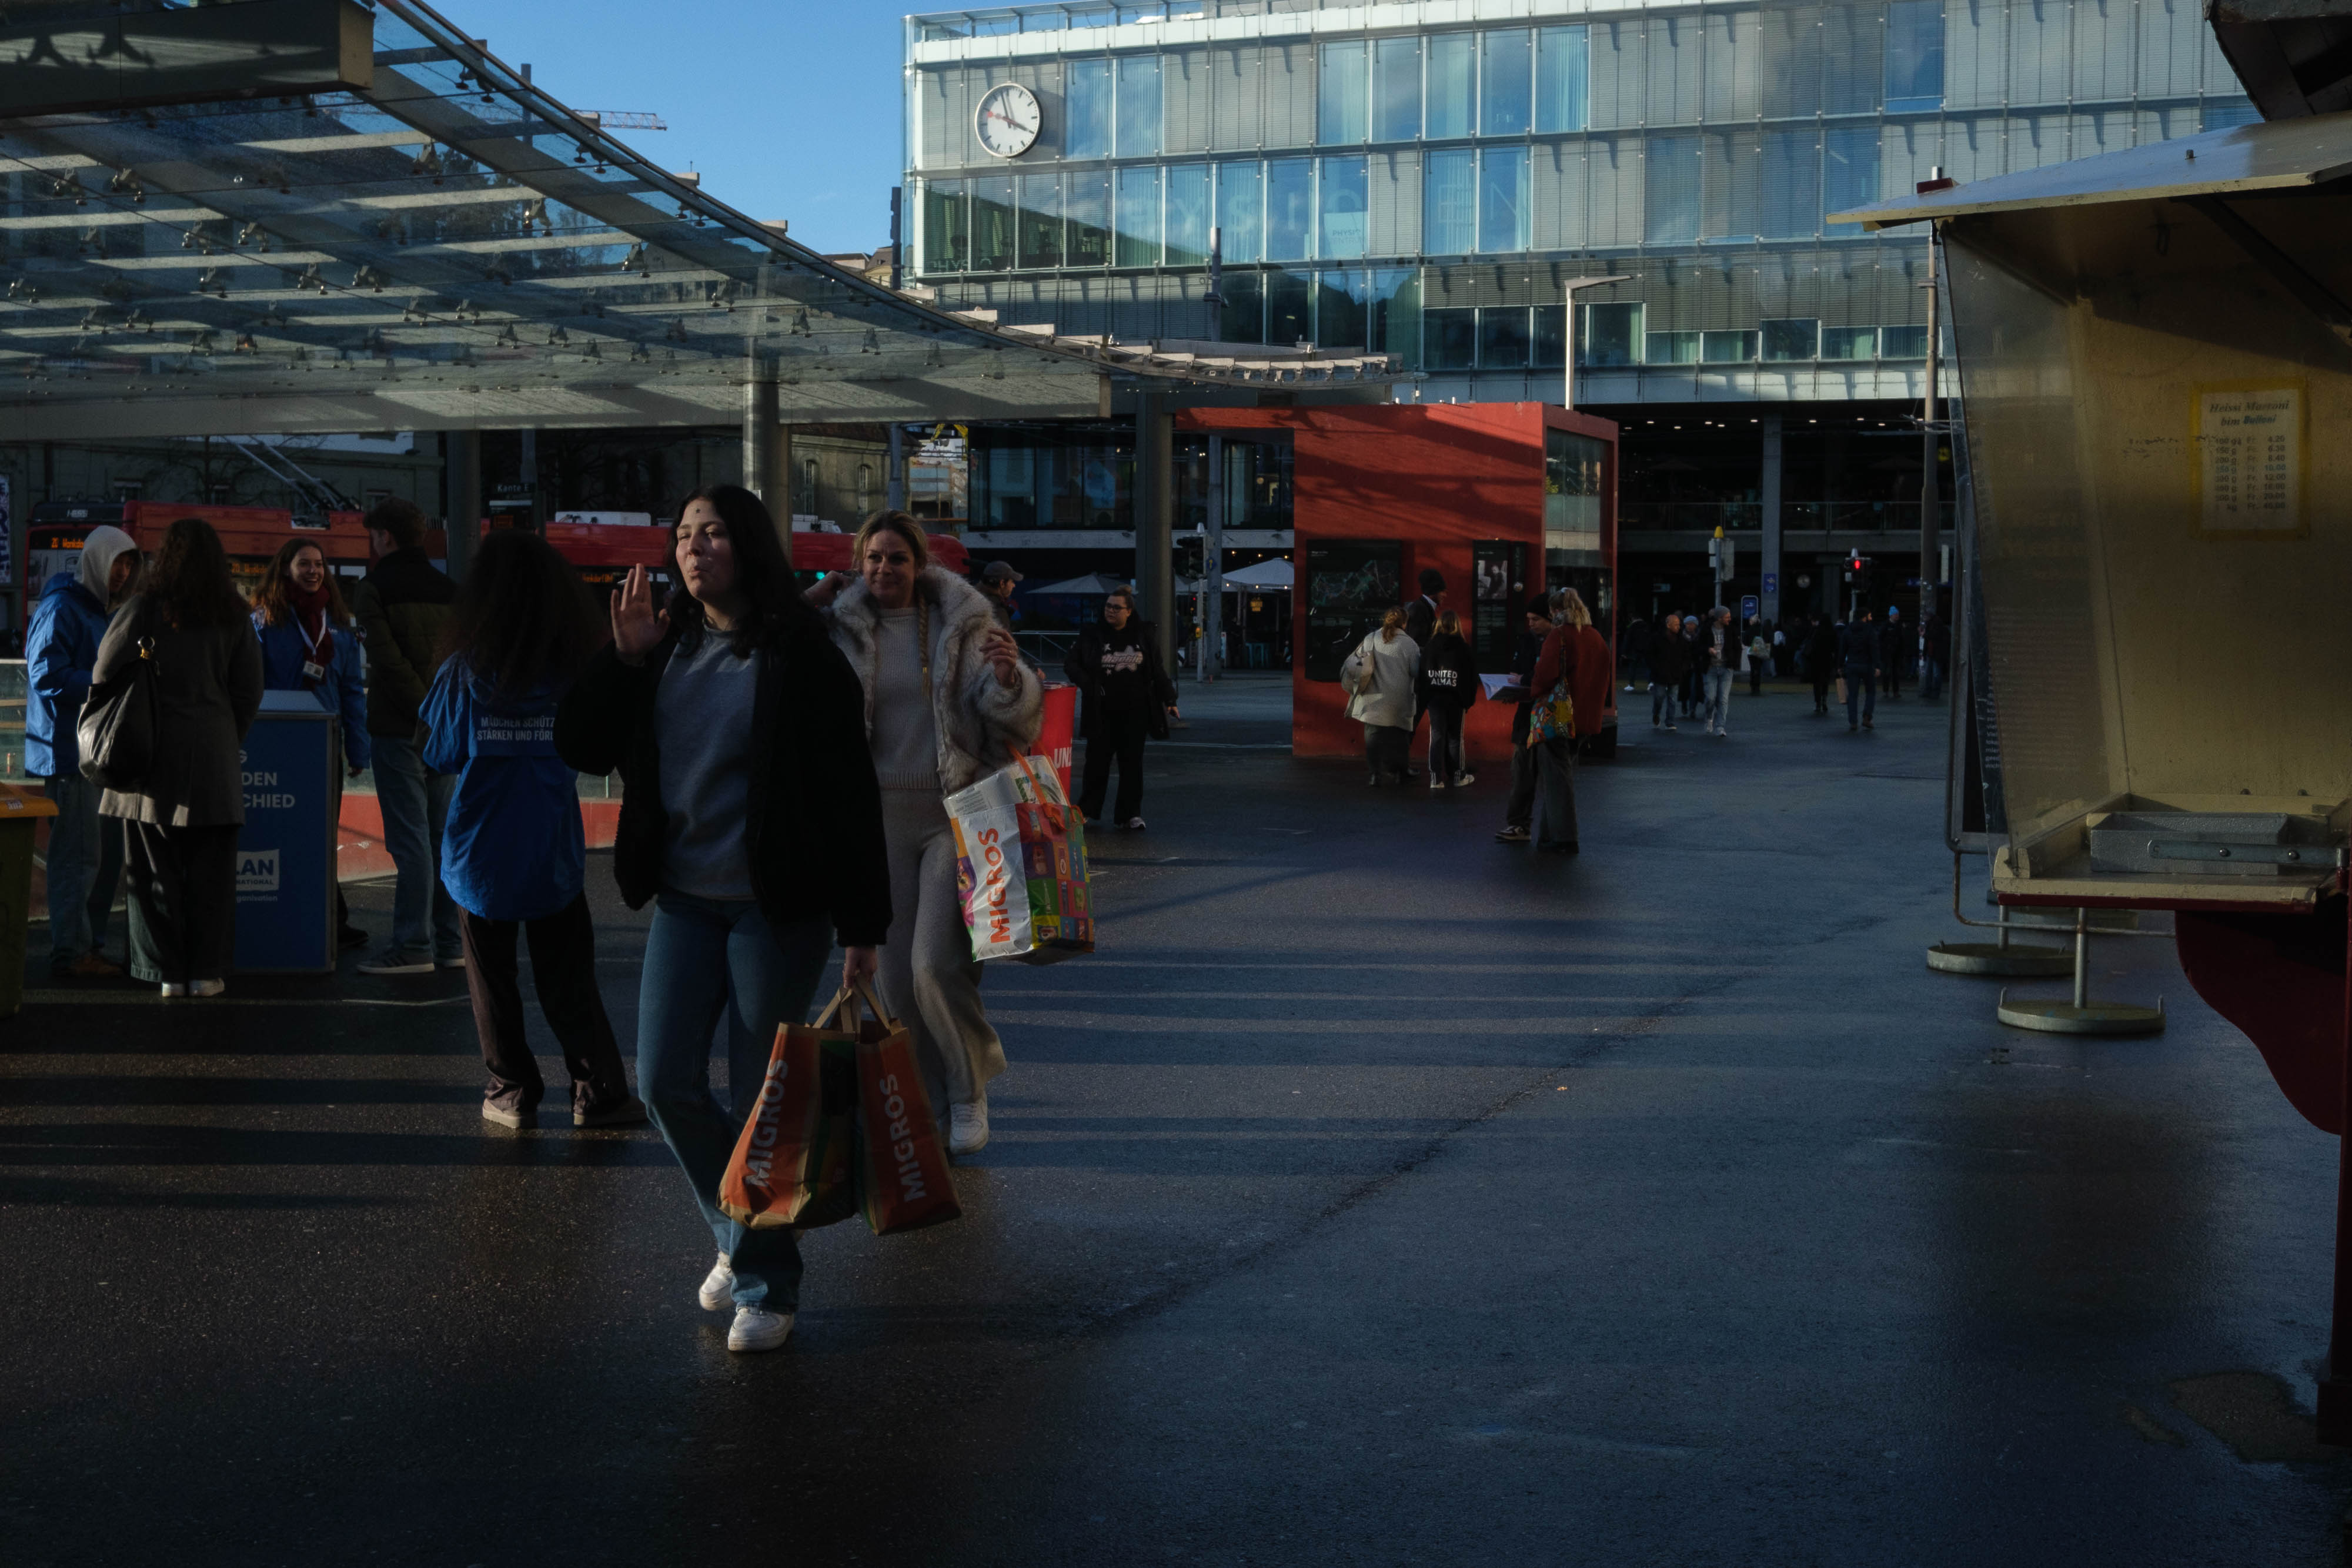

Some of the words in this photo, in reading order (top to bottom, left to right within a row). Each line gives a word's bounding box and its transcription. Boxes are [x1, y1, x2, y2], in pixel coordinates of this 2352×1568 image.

[2210, 402, 2242, 413] Heissi
[2245, 400, 2290, 411] Marroni
[2220, 417, 2241, 427] bim
[497, 484, 522, 493] Kante
[524, 483, 530, 492] E
[1428, 669, 1458, 678] UNITED
[1431, 678, 1458, 687] ALMAS
[481, 715, 522, 728] MÄDCHEN
[523, 715, 555, 728] SCHÜTZ
[477, 728, 513, 741] STÄRKEN
[515, 729, 532, 741] UND
[242, 771, 278, 786] DEN
[242, 793, 296, 808] CHIED
[236, 859, 274, 875] AN
[977, 827, 1011, 944] MIGROS
[746, 1059, 789, 1188] MIGROS
[880, 1073, 927, 1203] MIGROS
